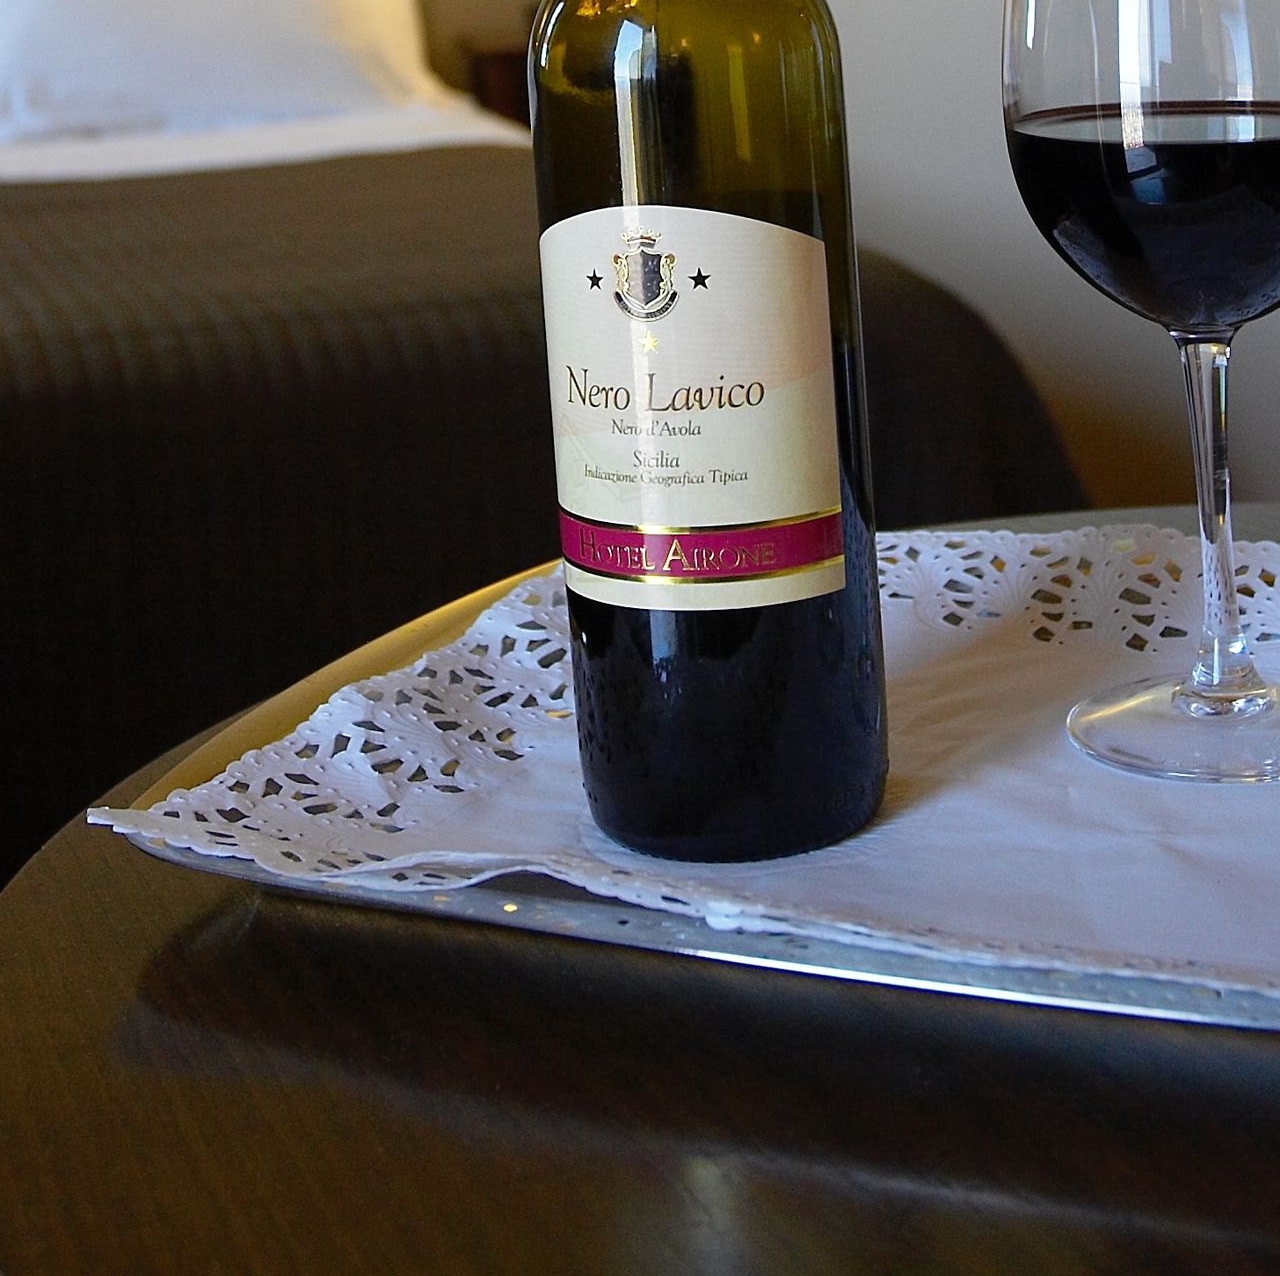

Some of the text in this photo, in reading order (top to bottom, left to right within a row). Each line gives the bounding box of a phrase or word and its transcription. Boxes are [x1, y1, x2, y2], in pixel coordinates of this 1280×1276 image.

[566, 364, 765, 412] Nero Lavico
[611, 418, 702, 437] Nero d'Avola
[633, 449, 680, 469] Sicilia
[584, 464, 749, 488] Indicazione Geografica Tipica
[579, 528, 656, 571] HOTEL
[662, 537, 777, 573] AIRONE
